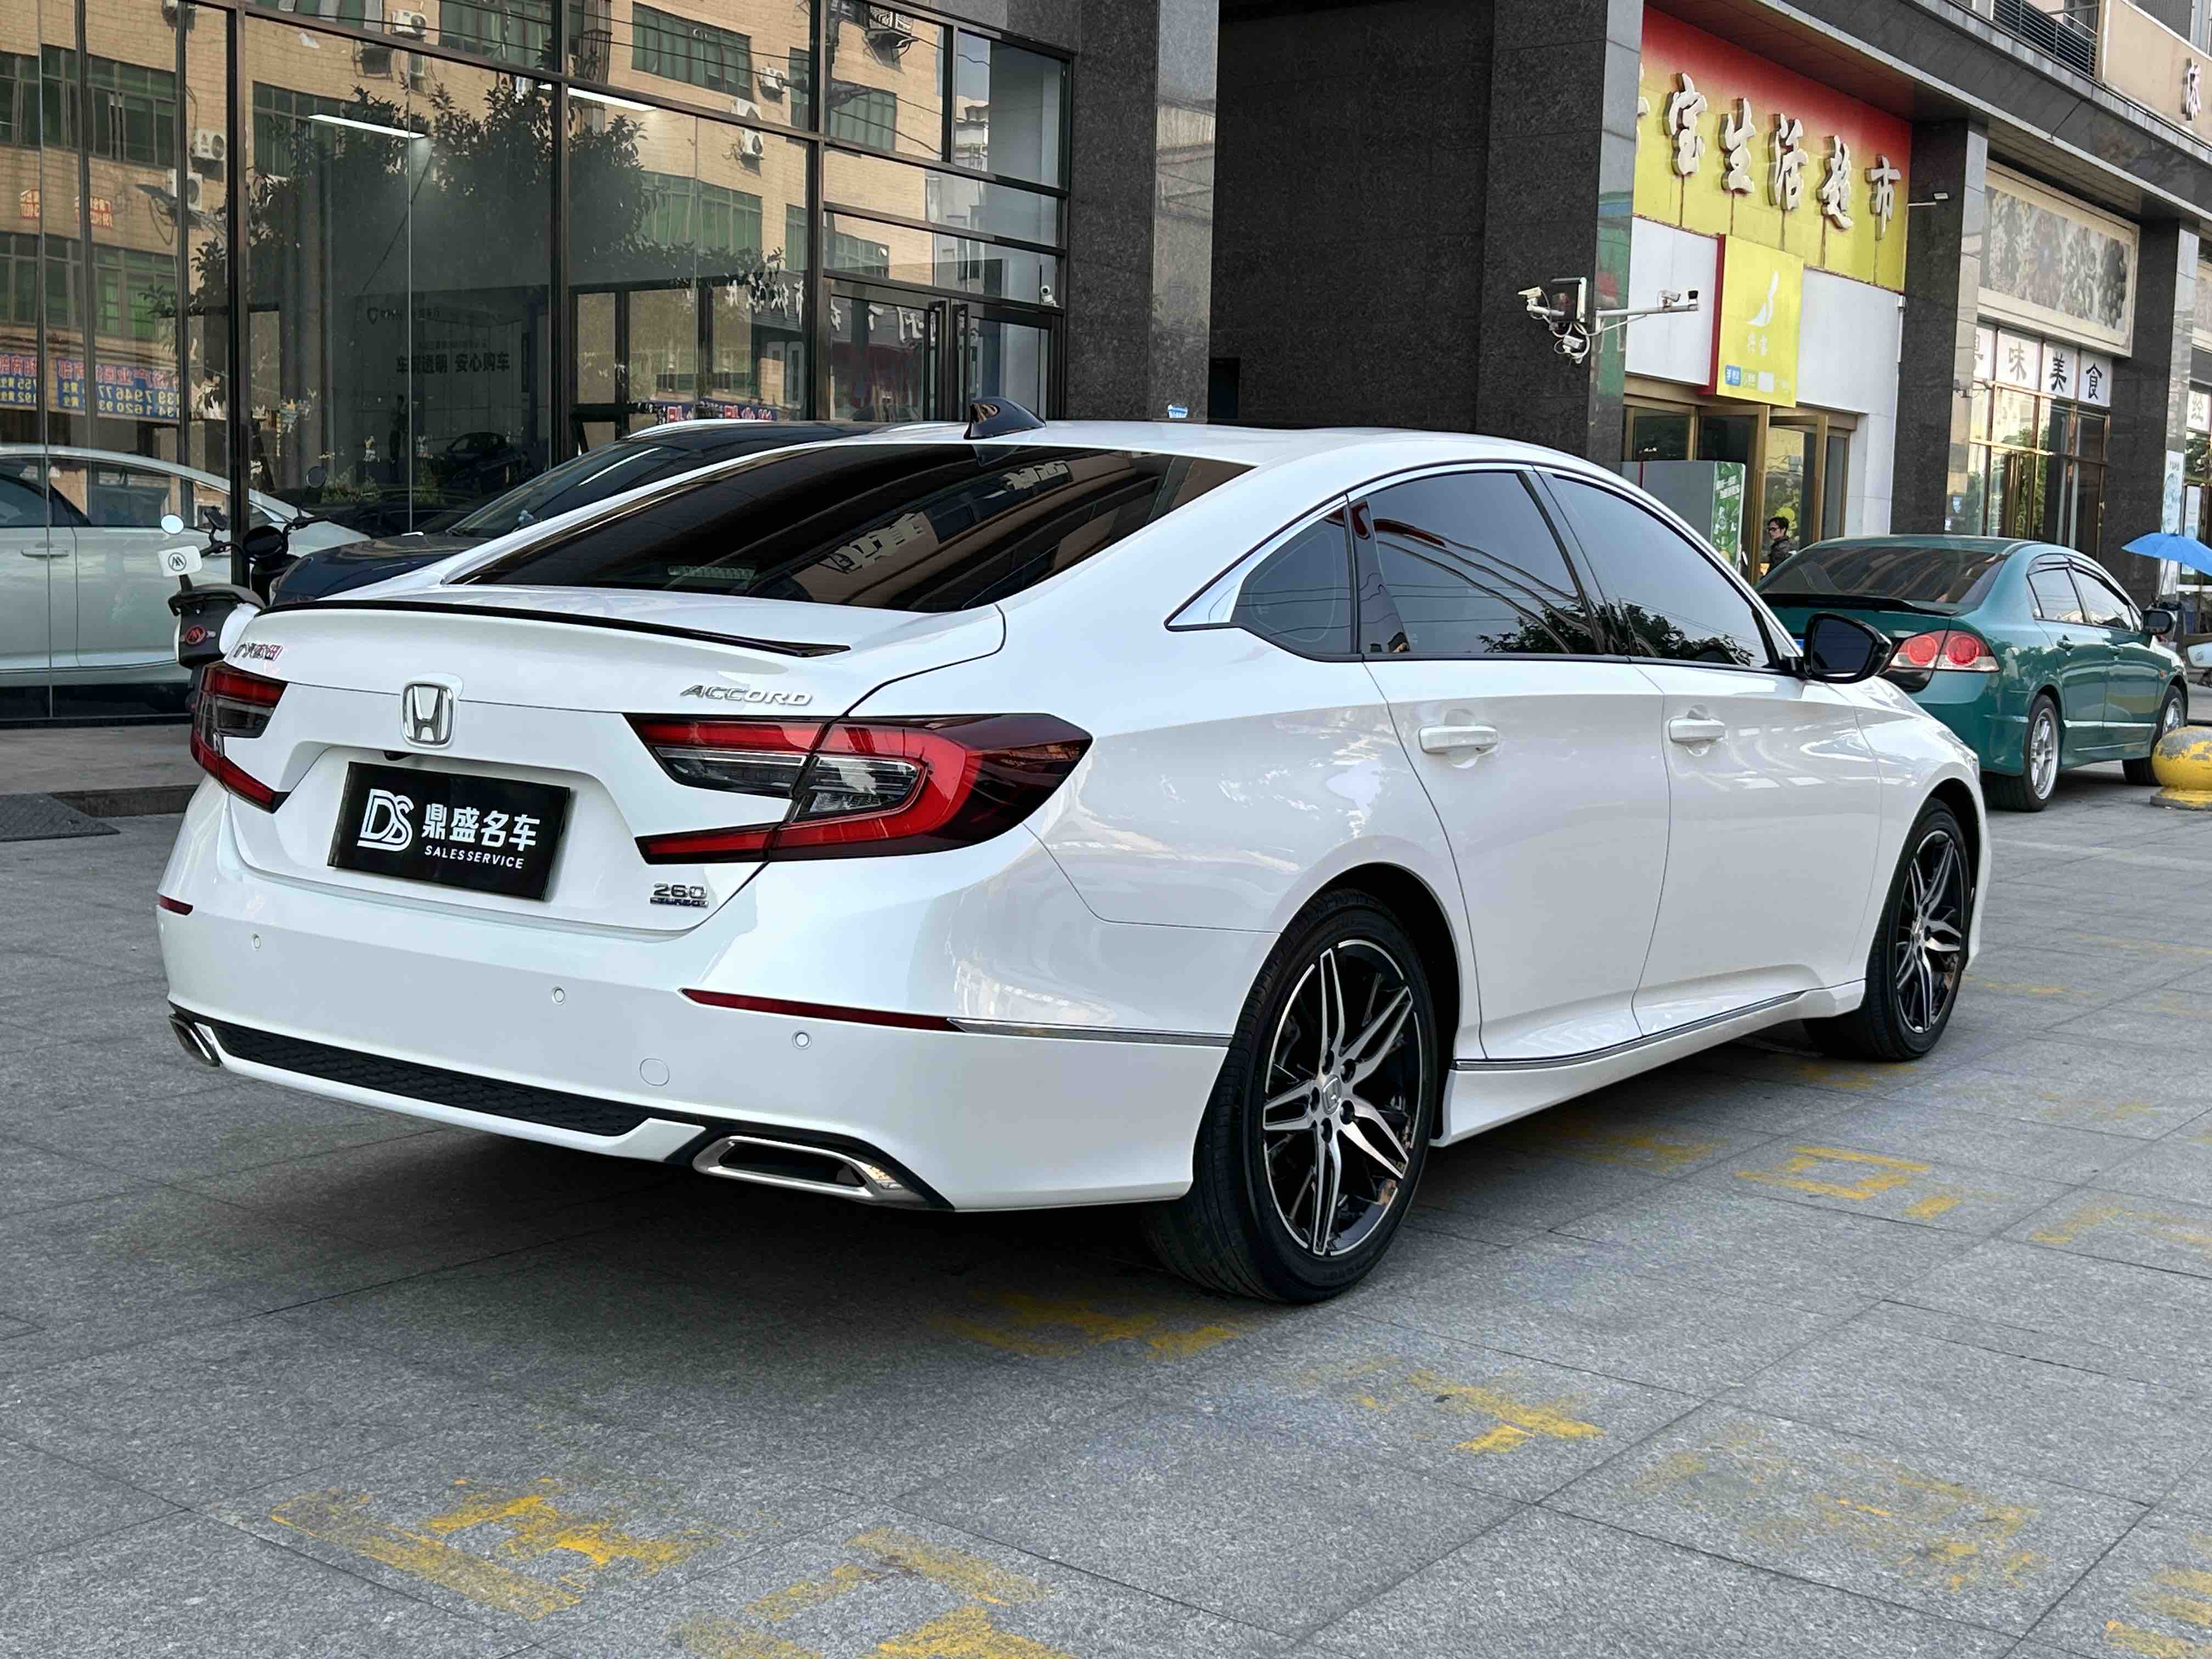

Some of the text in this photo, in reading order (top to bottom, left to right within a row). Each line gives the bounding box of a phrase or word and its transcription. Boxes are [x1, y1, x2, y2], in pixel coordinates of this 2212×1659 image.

[1637, 63, 1901, 241] 宝生活超市
[680, 684, 813, 706] ACCORD
[421, 803, 541, 851] 鼎盛名车
[424, 845, 525, 870] SALESSERVICE
[653, 882, 708, 899] 260
